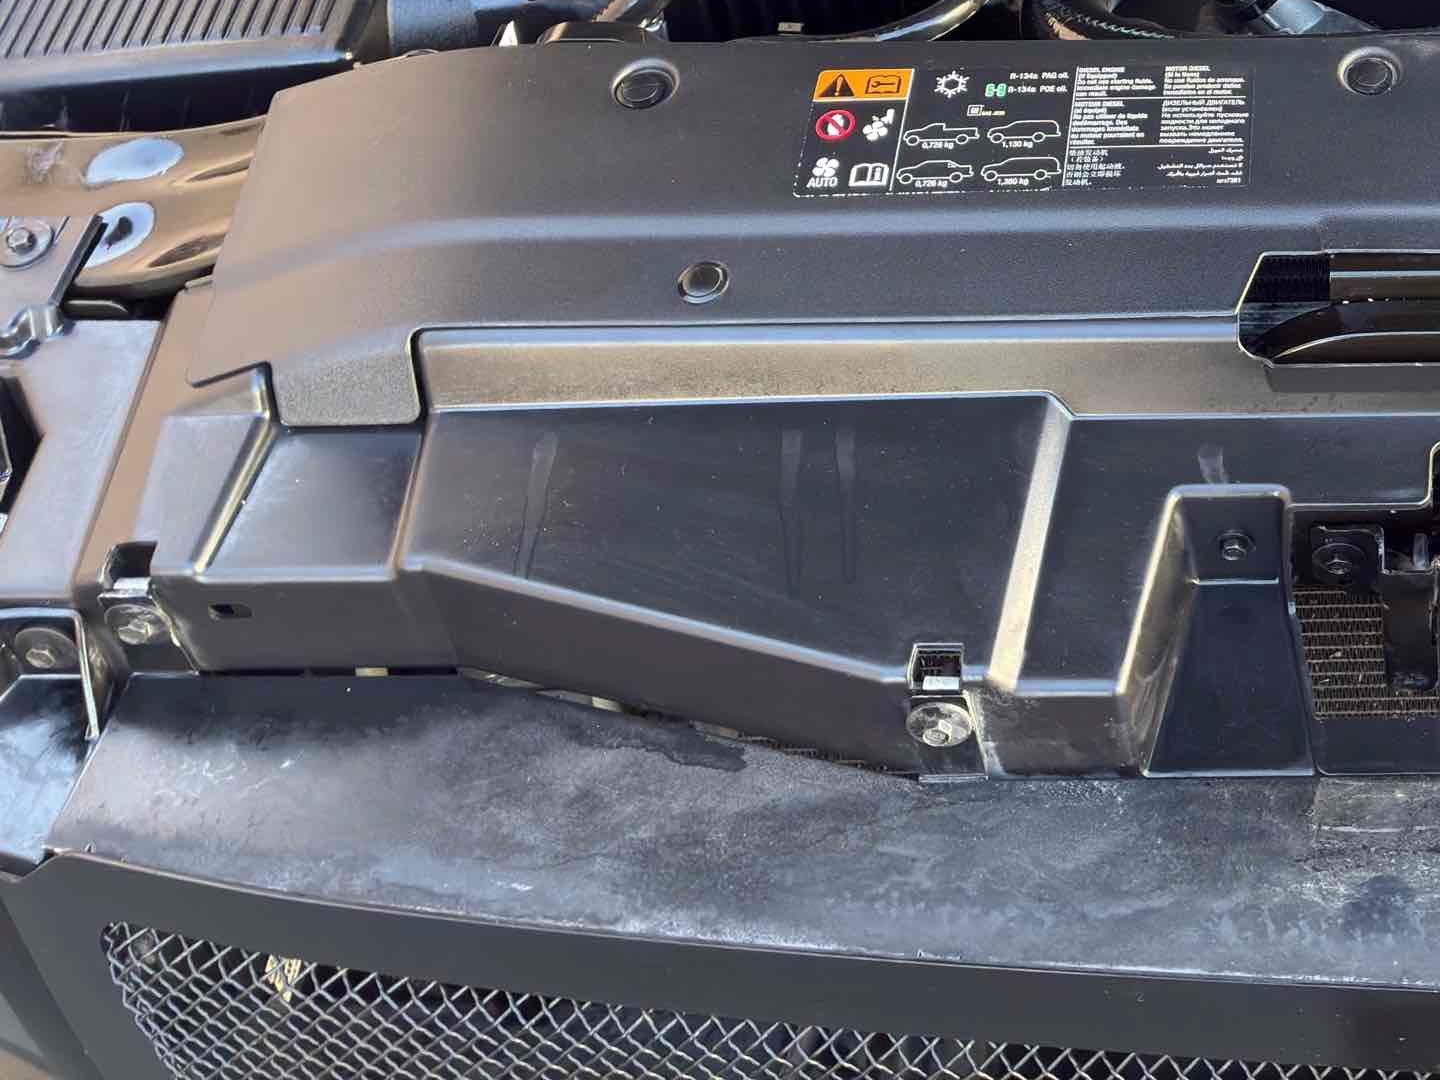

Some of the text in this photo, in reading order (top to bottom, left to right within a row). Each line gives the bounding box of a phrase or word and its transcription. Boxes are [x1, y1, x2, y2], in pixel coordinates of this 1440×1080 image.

[943, 141, 954, 150] kg
[1023, 141, 1034, 149] kg
[806, 177, 838, 189] AUTO
[937, 179, 948, 189] kg
[1018, 177, 1029, 187] kg
